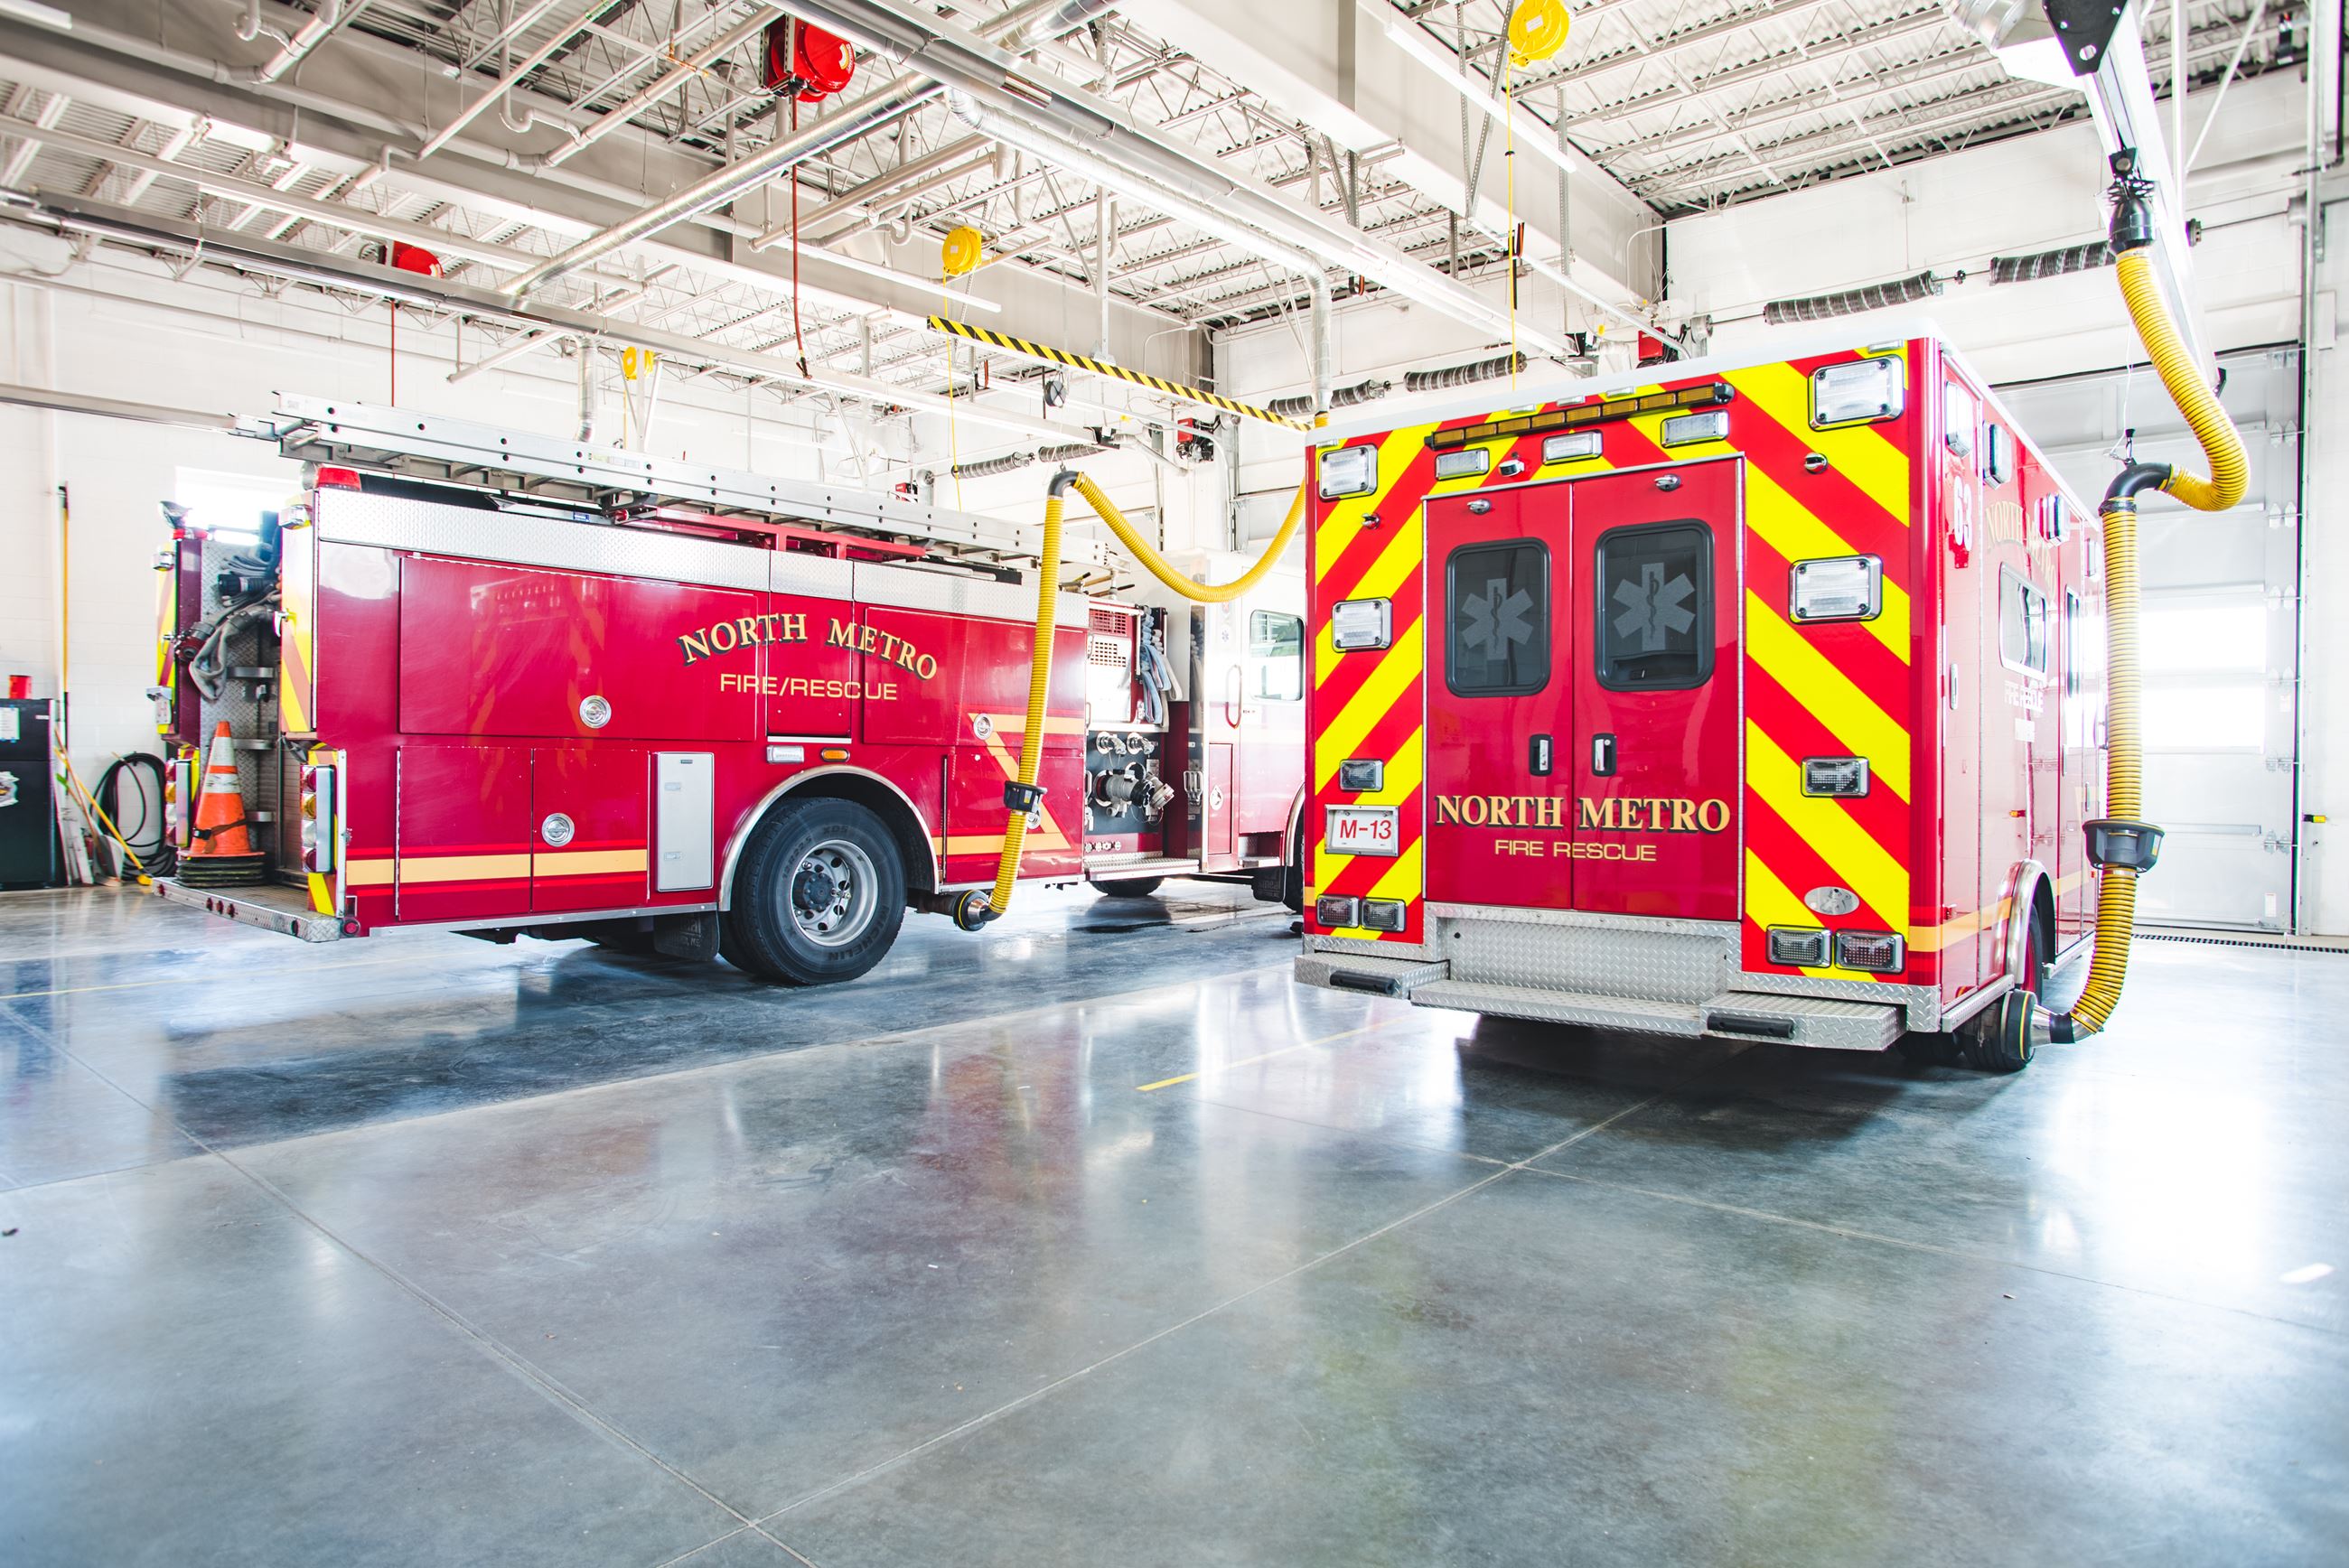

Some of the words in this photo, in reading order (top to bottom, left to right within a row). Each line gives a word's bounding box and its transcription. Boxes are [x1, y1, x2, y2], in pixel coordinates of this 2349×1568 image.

[1953, 475, 1973, 552] 63
[1986, 499, 2026, 548] NORTH
[678, 613, 808, 665] NORTH
[826, 618, 938, 680] METRO
[720, 673, 898, 701] FIRE/RESCUE
[1340, 819, 1392, 840] M-13
[1436, 795, 1565, 828] NORTH
[1577, 798, 1731, 833] METRO
[1494, 839, 1544, 858] FIRE
[1553, 841, 1657, 863] RESCUE
